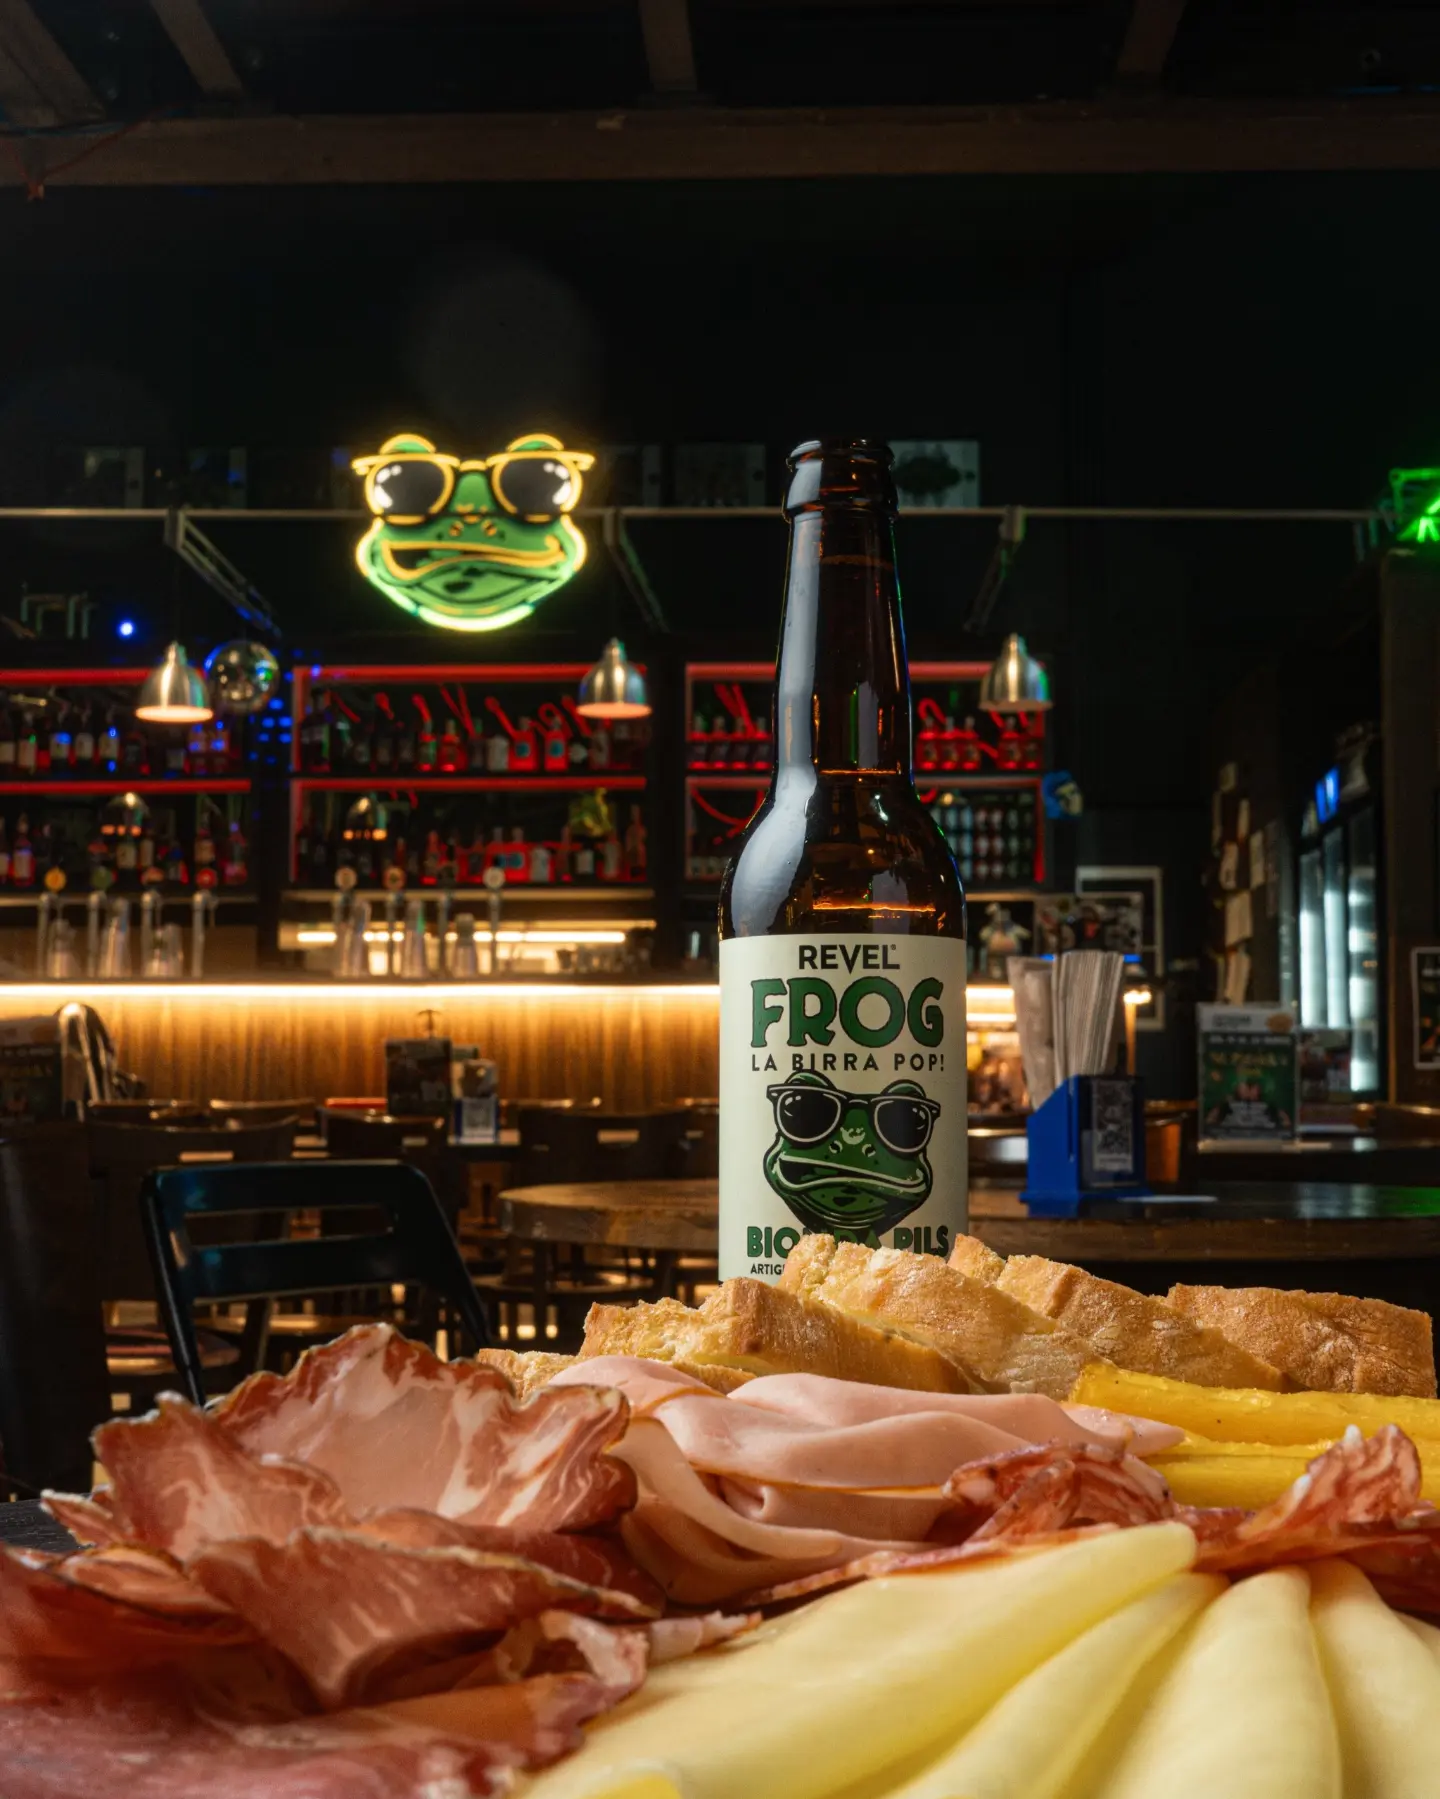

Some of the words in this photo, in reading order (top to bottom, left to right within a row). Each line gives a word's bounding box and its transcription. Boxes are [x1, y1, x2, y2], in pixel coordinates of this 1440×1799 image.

[750, 975, 945, 1048] FROG
[751, 1053, 778, 1072] LA
[791, 1052, 879, 1072] BIRRA
[893, 1052, 945, 1072] POP!
[893, 1225, 950, 1258] PILS
